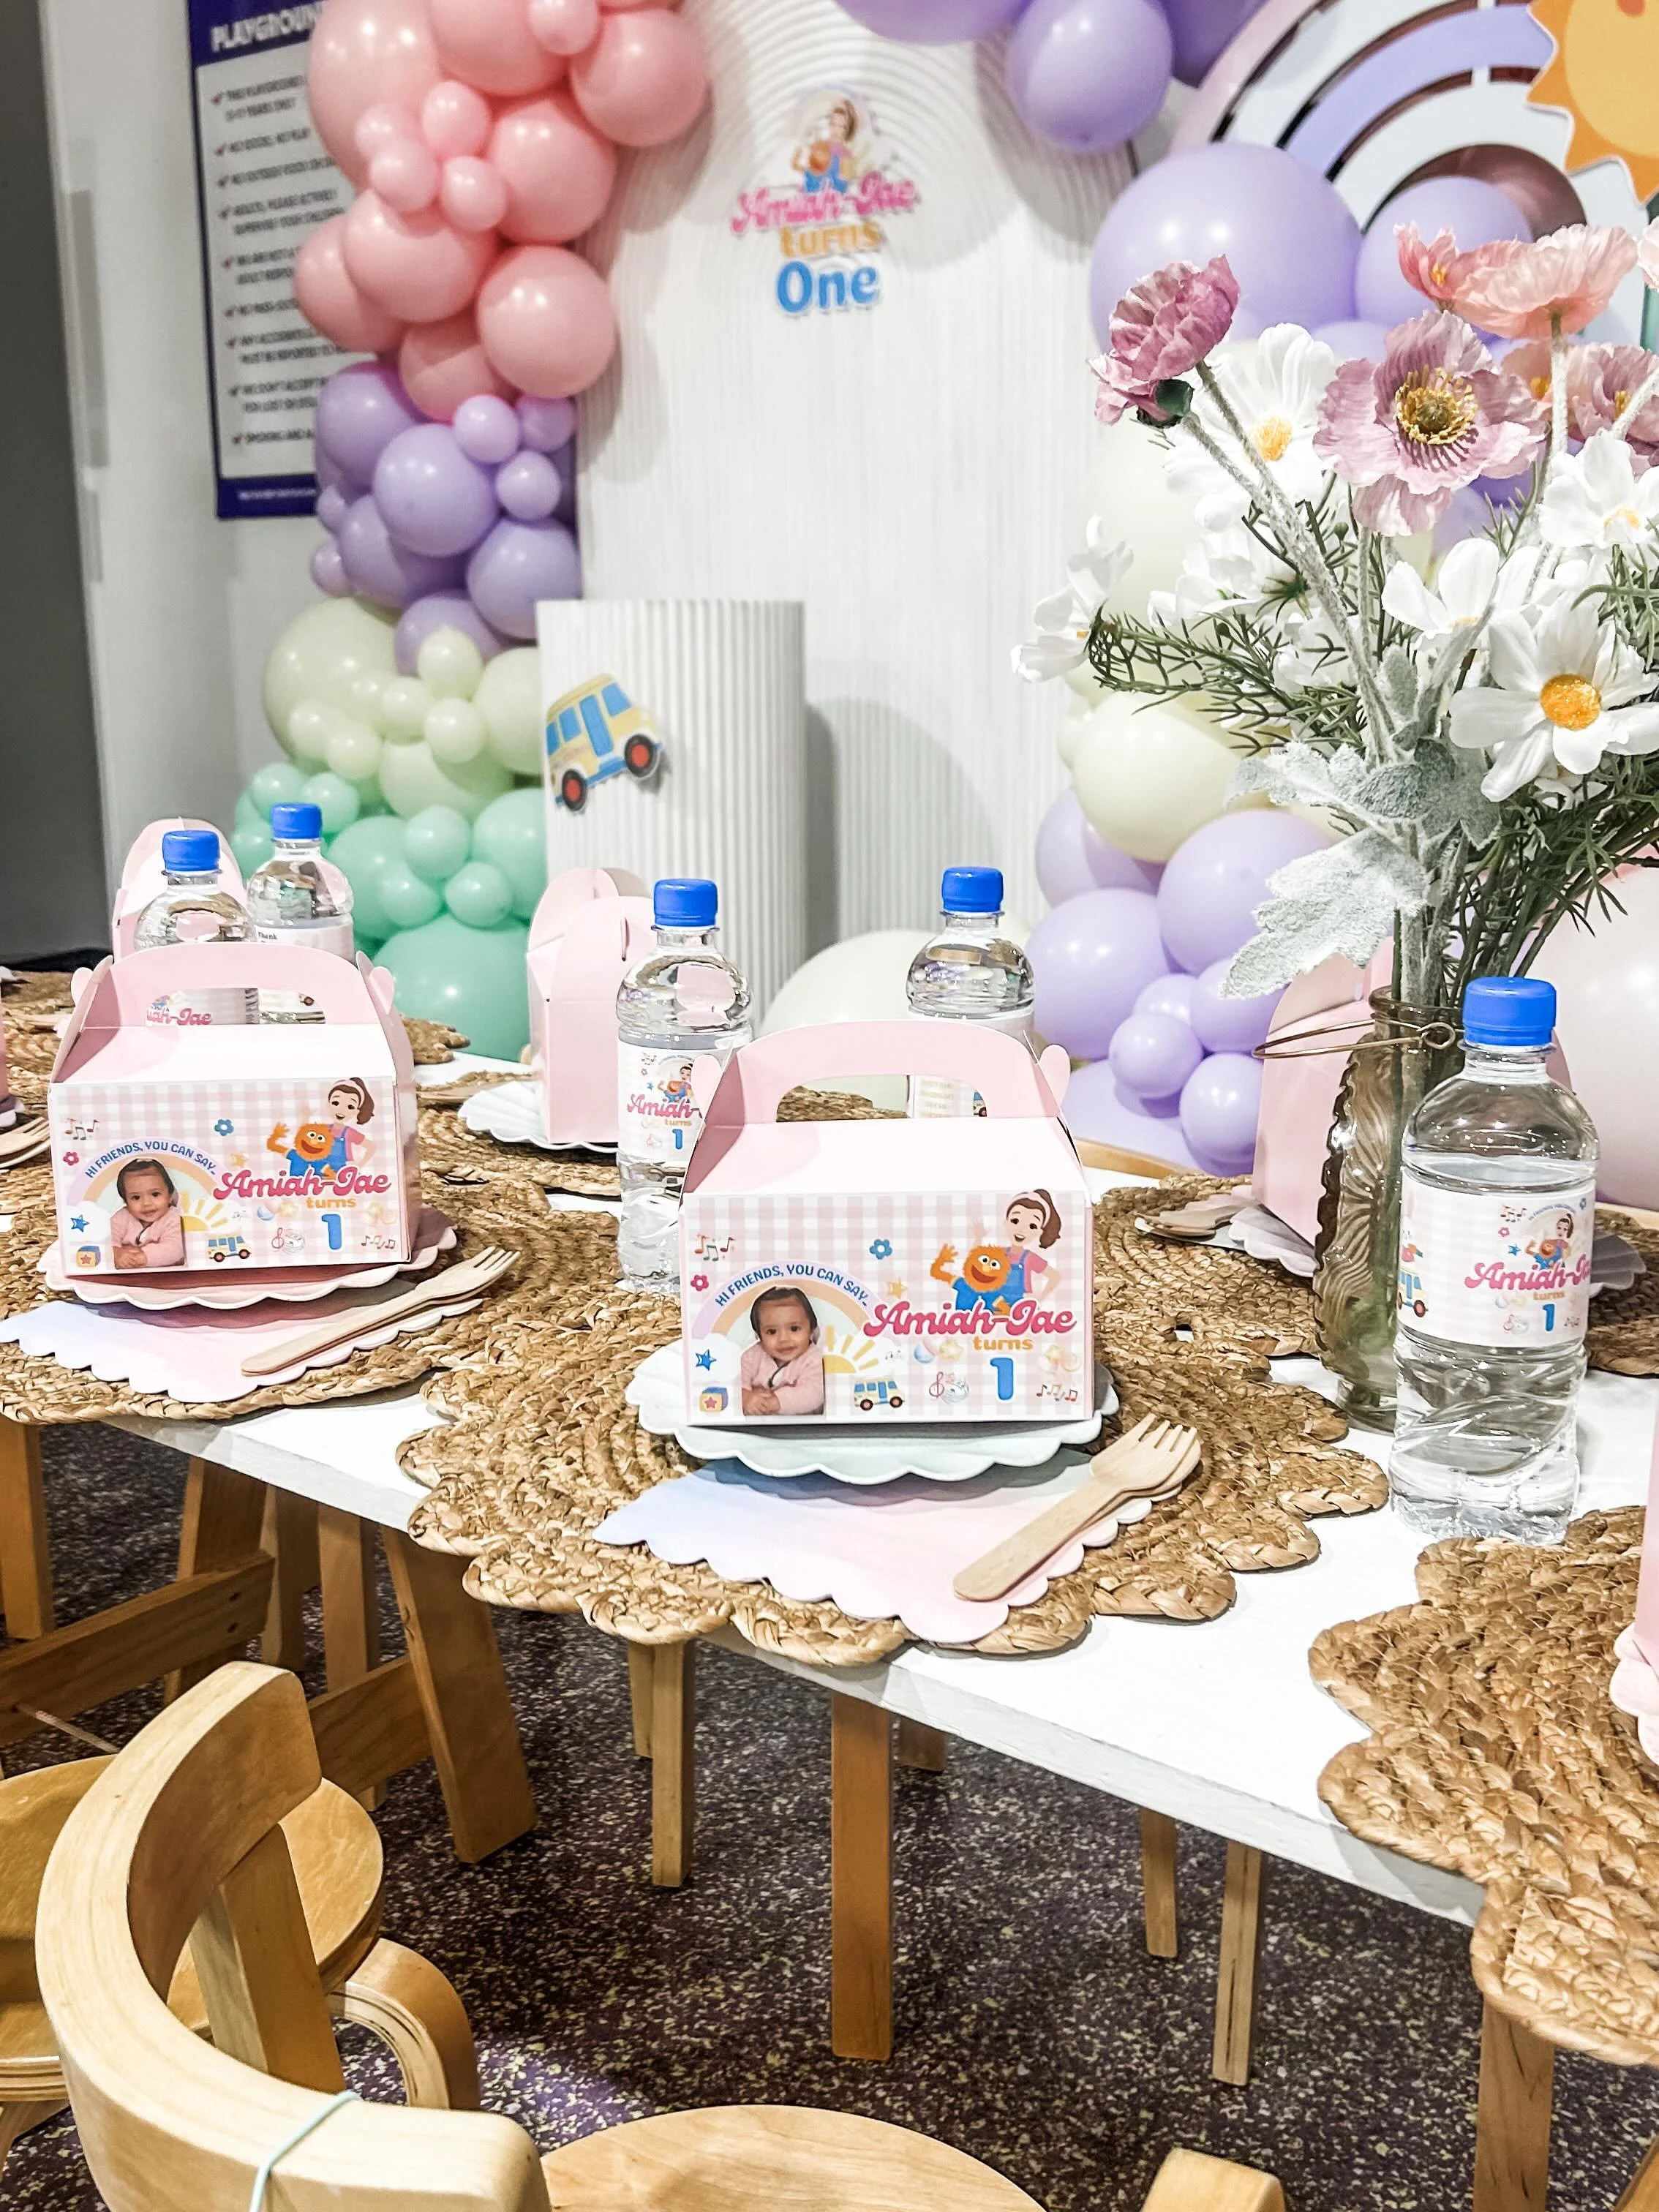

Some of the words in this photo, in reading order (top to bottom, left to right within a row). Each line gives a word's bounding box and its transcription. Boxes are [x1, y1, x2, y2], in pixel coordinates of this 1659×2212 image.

[780, 222, 884, 258] turns
[777, 261, 879, 313] One
[672, 1129, 683, 1149] 1
[85, 1165, 98, 1178] HI
[96, 1143, 143, 1169] FRIENDS,
[145, 1141, 168, 1151] YOU
[170, 1144, 194, 1158] CAN
[214, 1167, 392, 1200] Amiah-Jae
[306, 1197, 356, 1209] turns
[321, 1214, 342, 1250] 1
[715, 1292, 730, 1306] HI
[728, 1265, 784, 1295] FRIENDS,
[786, 1264, 814, 1276] YOU
[817, 1268, 843, 1286] CAN
[863, 1300, 1077, 1336] Amiah-Jae
[1543, 1304, 1554, 1331] 1
[973, 1336, 1034, 1350] turns
[990, 1357, 1014, 1401] 1
